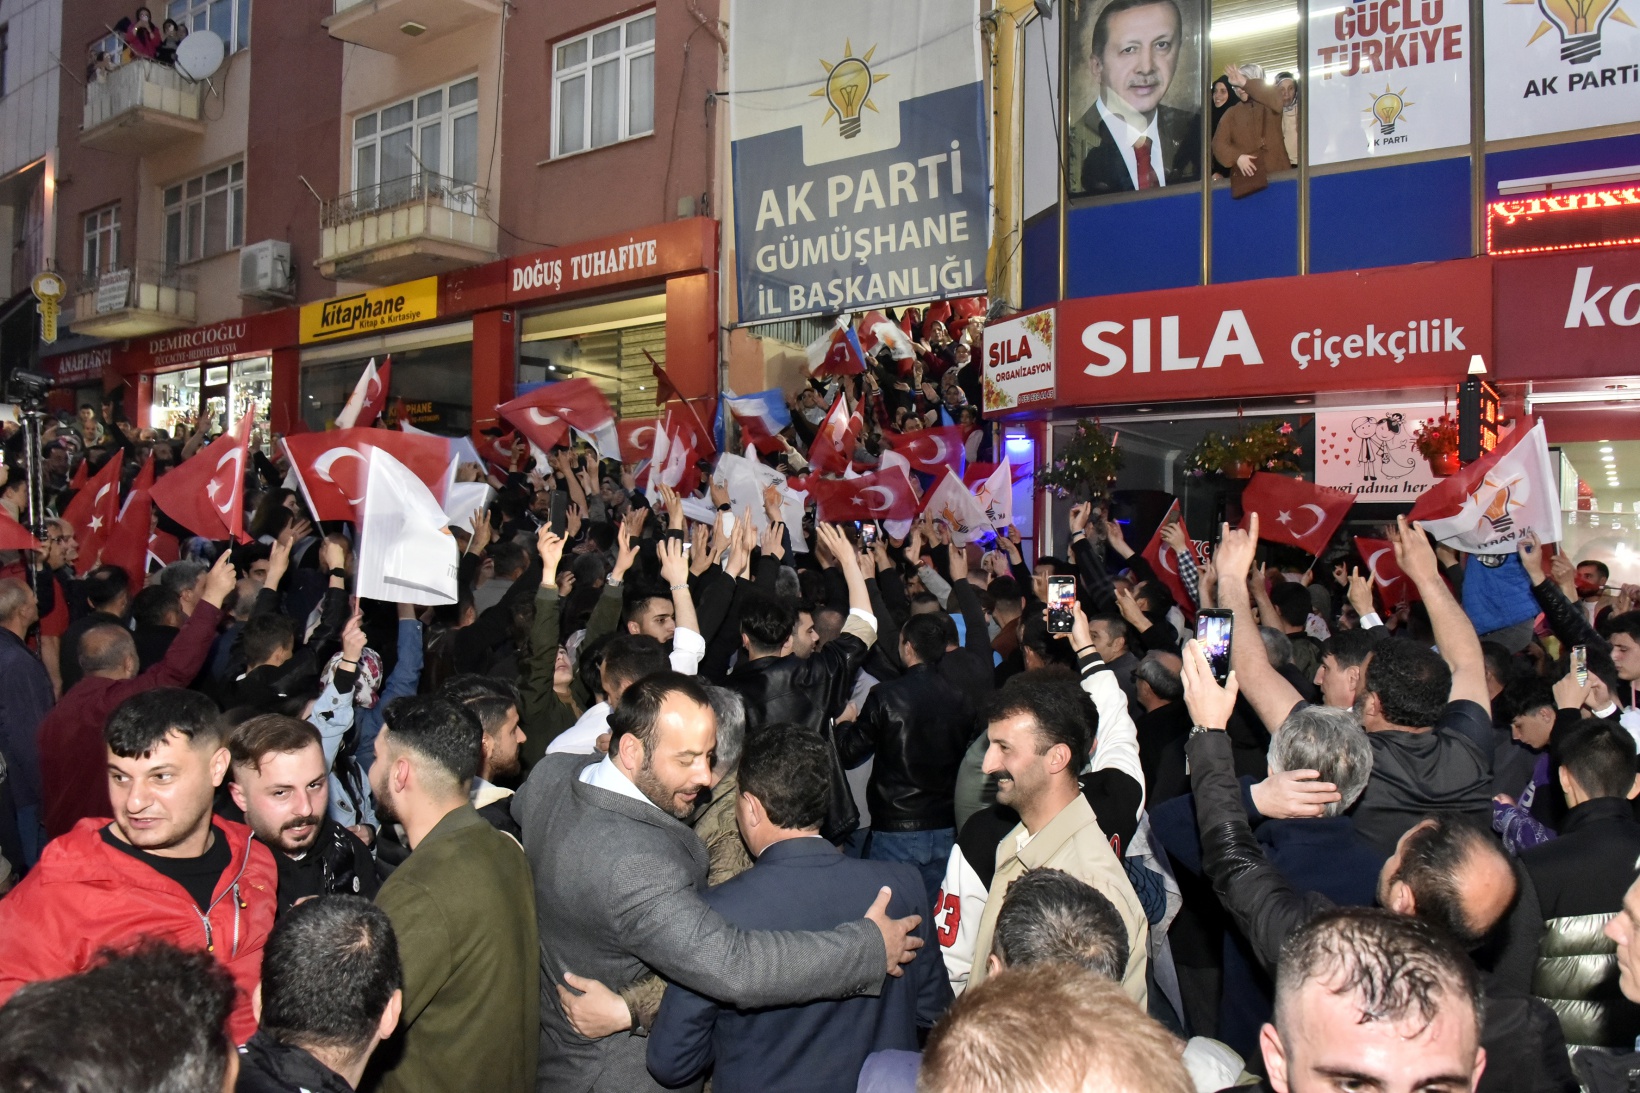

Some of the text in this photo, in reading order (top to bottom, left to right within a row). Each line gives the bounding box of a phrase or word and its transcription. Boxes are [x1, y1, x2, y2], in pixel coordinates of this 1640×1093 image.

[1317, 24, 1463, 81] TÜRKİYE
[1523, 75, 1558, 98] AK
[755, 139, 963, 232] AK PARTİ
[755, 210, 969, 273] GÜMÜŞHANE
[512, 237, 657, 292] DOĞUŞ TUHAFİYE
[757, 254, 973, 316] İL BAŞKANLIĞI
[320, 294, 405, 331] kitaphane
[359, 319, 378, 329] Kitap
[380, 316, 385, 325] &
[149, 323, 247, 355] DEMİRCİOĞLU
[989, 335, 1032, 368] SILA
[1080, 309, 1467, 378] SILA Çiçekçilik
[996, 361, 1052, 383] ORGANİZASYON
[1356, 481, 1398, 494] adına
[1402, 480, 1427, 493] her
